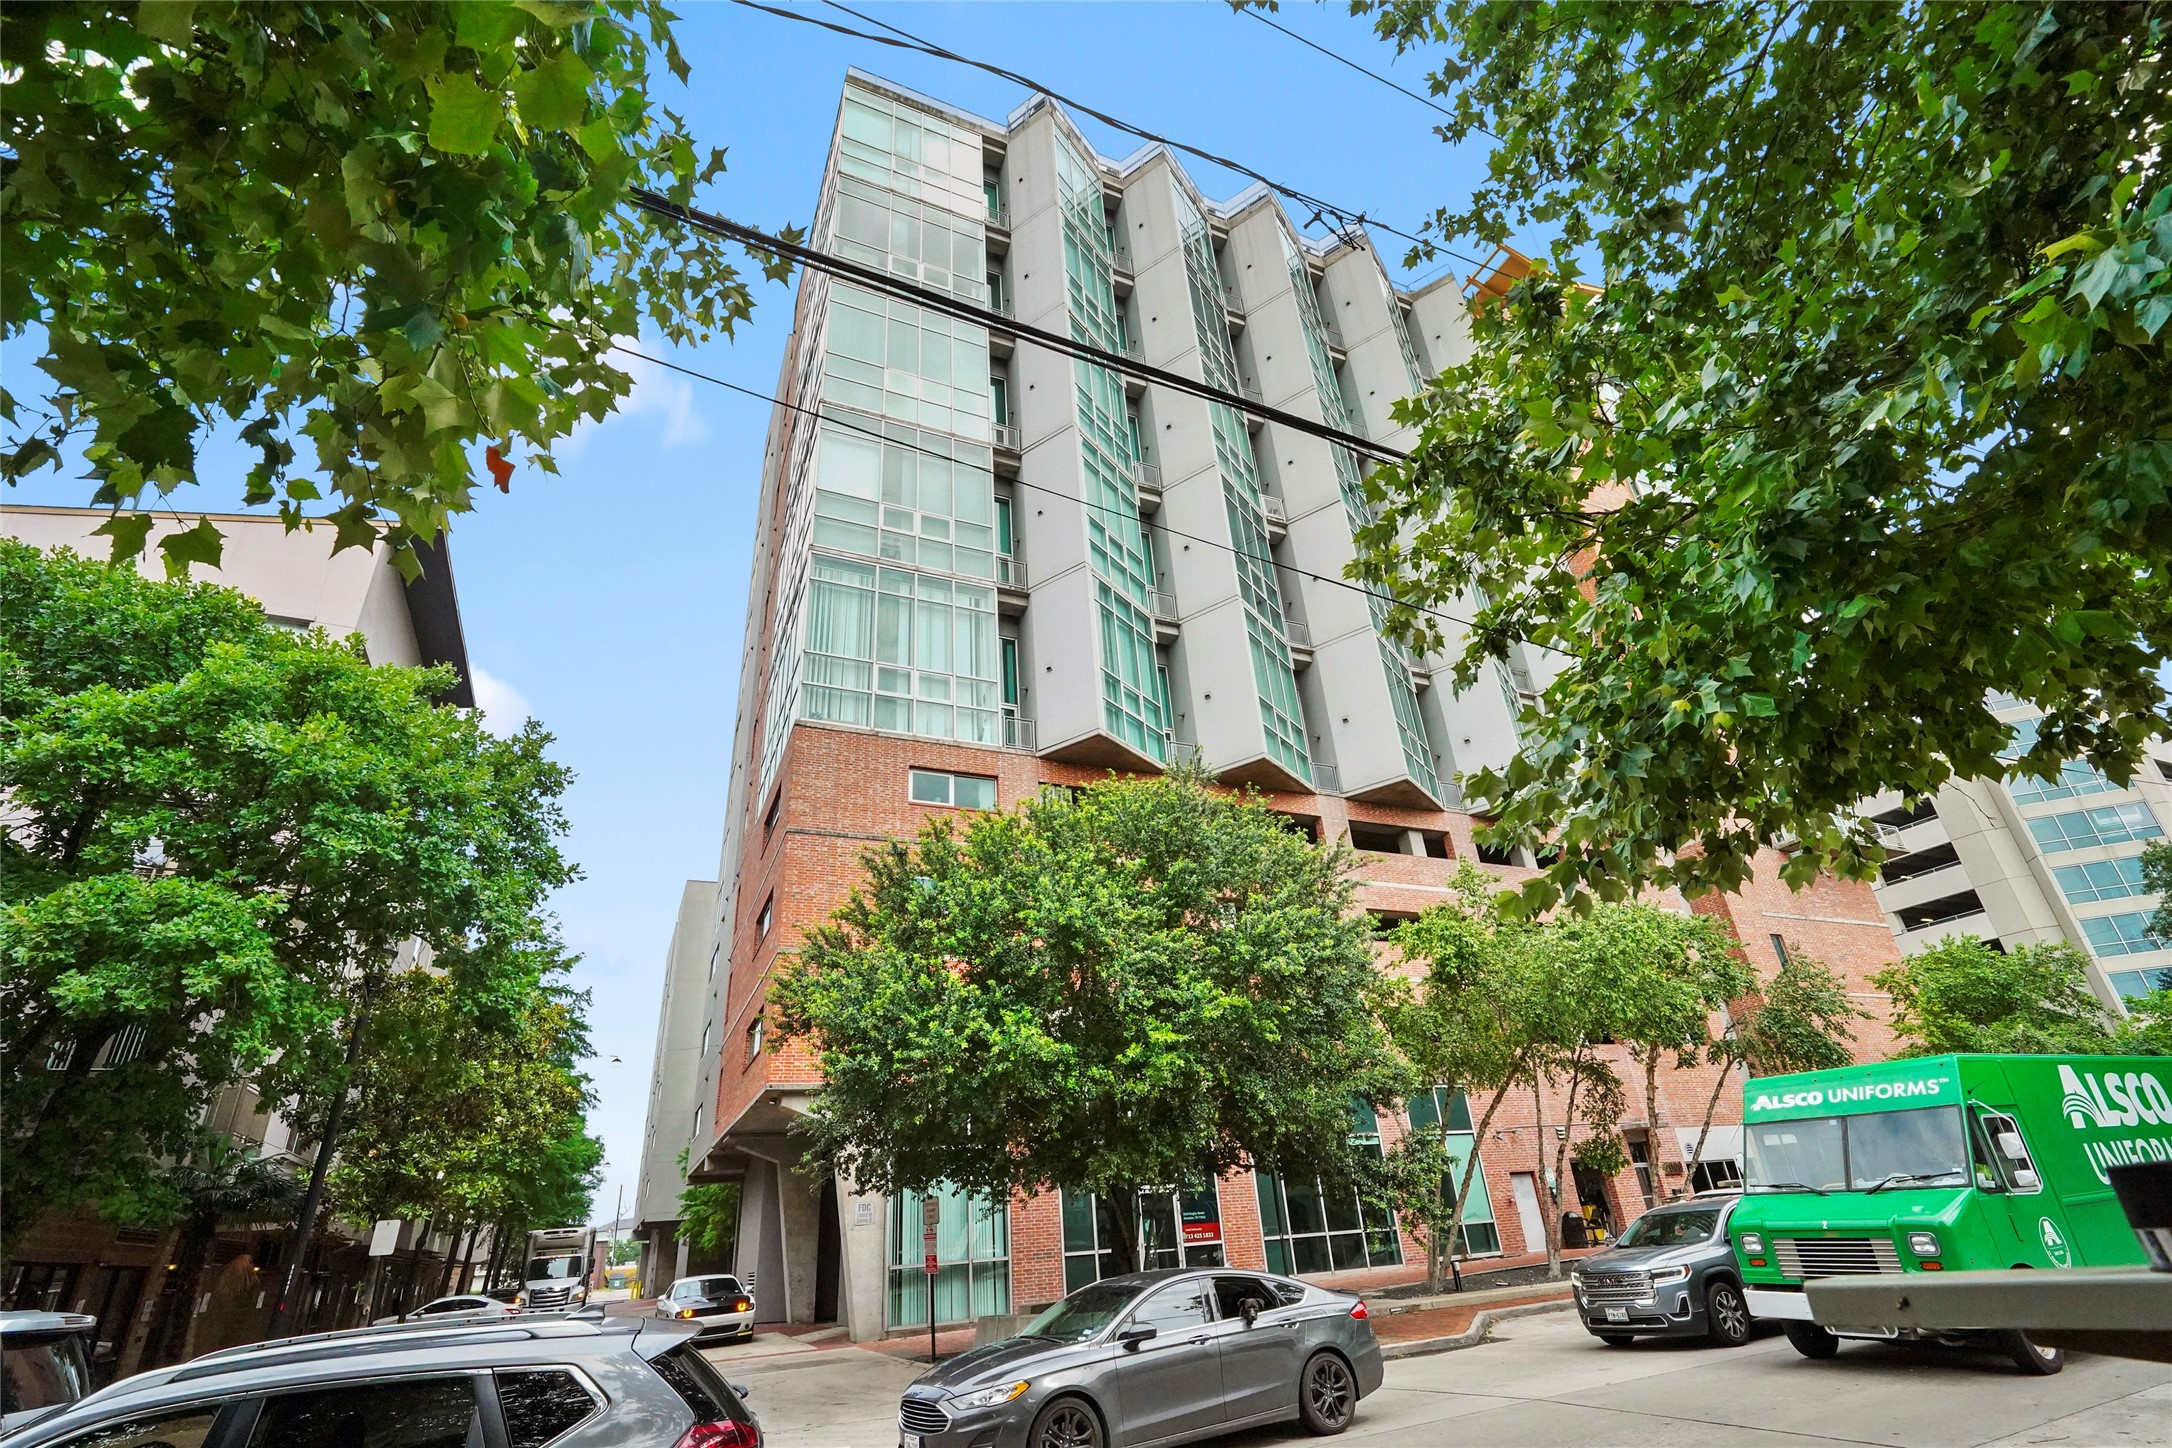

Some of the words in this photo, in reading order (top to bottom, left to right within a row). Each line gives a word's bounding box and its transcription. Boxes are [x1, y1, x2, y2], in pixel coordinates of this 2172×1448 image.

[1750, 1091, 1824, 1111] ALSCO
[2057, 1065, 2172, 1129] ALSCO
[858, 1203, 872, 1212] FDC
